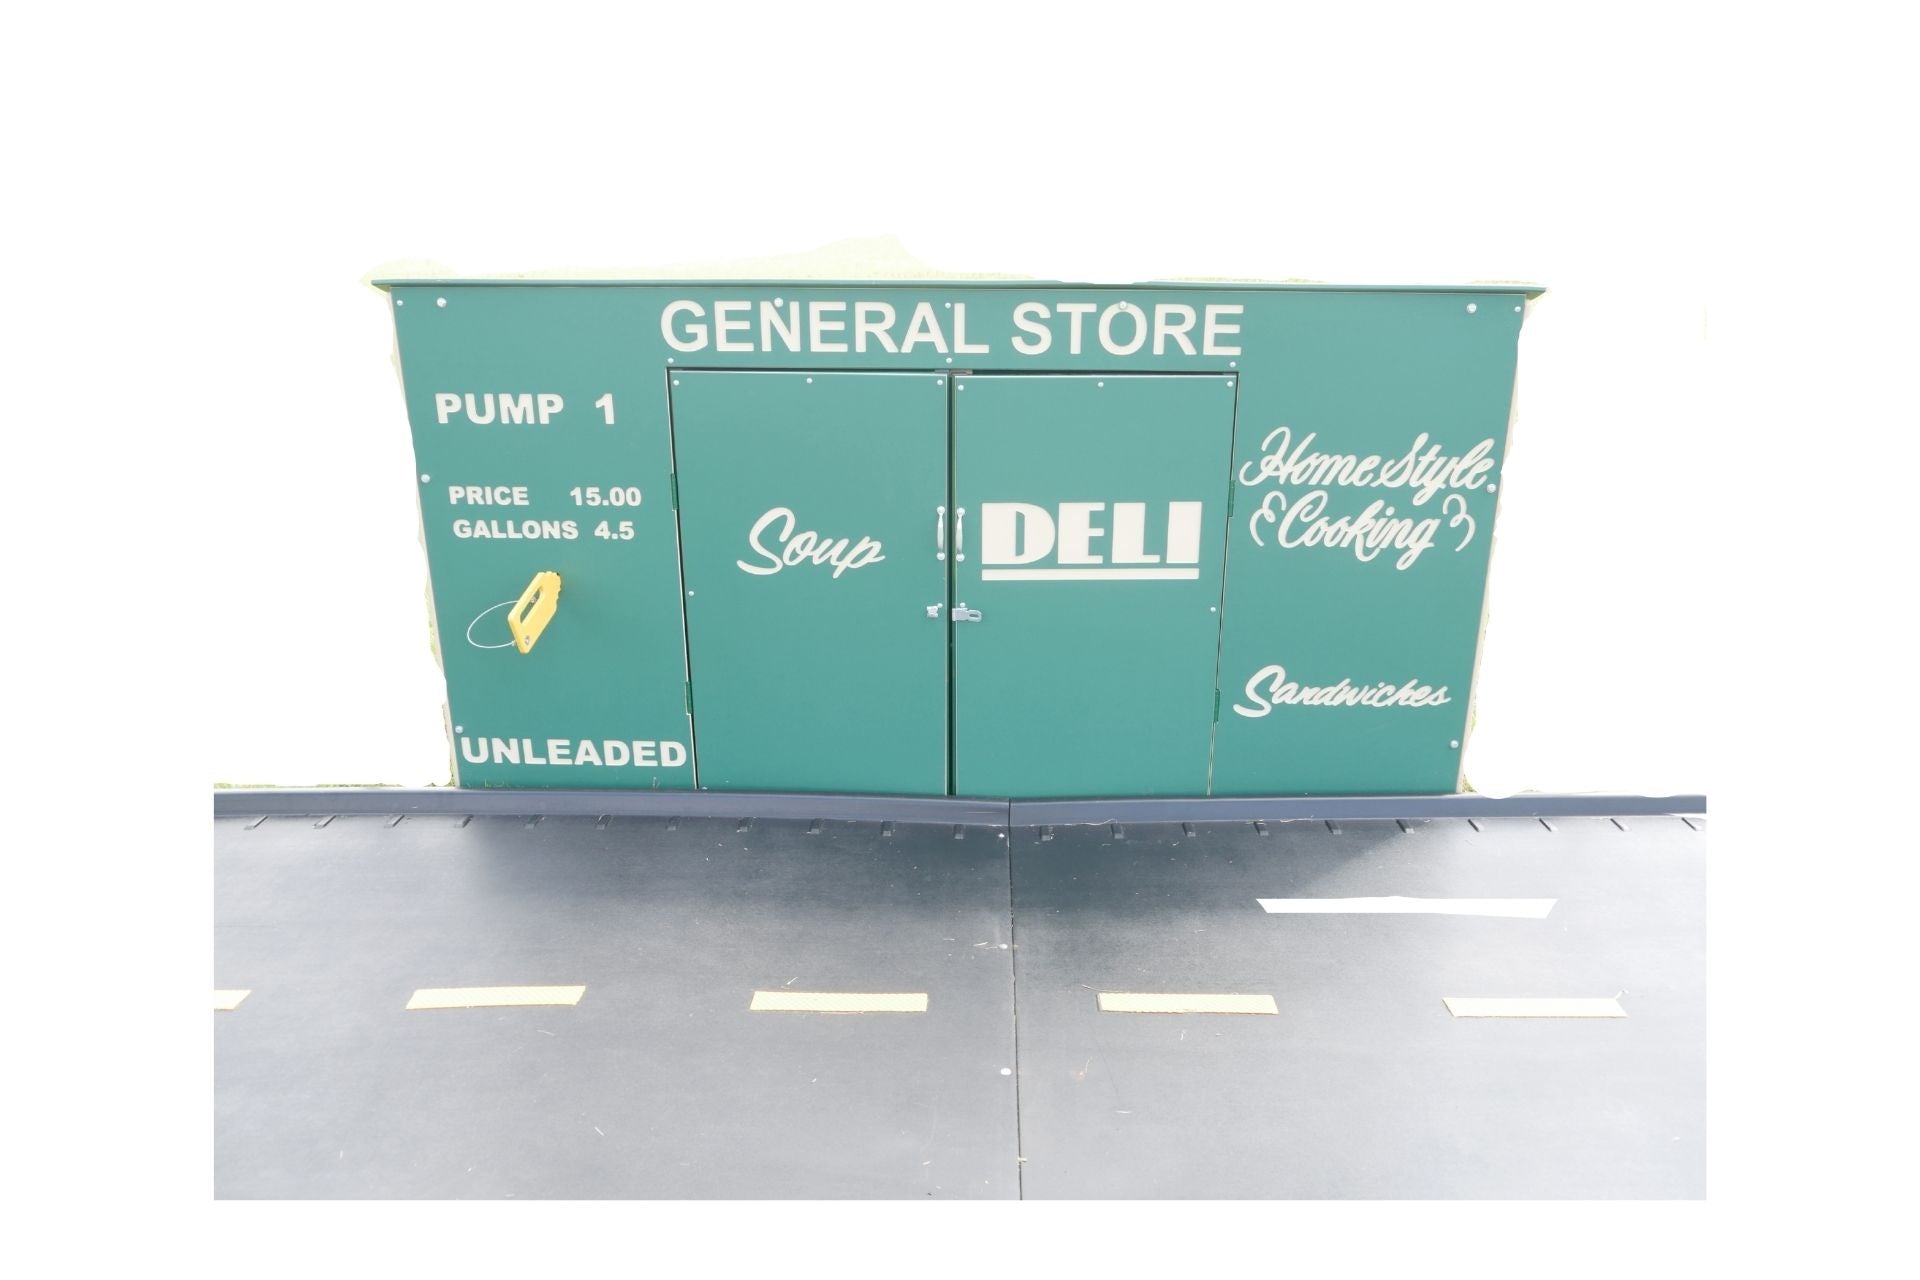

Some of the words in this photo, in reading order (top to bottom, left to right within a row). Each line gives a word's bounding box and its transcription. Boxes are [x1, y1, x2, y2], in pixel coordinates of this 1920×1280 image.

[660, 300, 990, 354] GENERAL
[1011, 302, 1244, 356] STORE
[435, 393, 564, 425] PUMP
[595, 393, 615, 425] 1
[448, 486, 530, 506] PRICE
[570, 487, 642, 507] 15.00
[453, 519, 579, 540] GALLONS
[594, 520, 635, 540] 4.5
[736, 507, 886, 579] Soup
[981, 501, 1202, 565] DELI
[1277, 490, 1441, 571] Cooking
[1233, 665, 1451, 718] Sandwiches
[461, 737, 687, 767] UNLEADED
